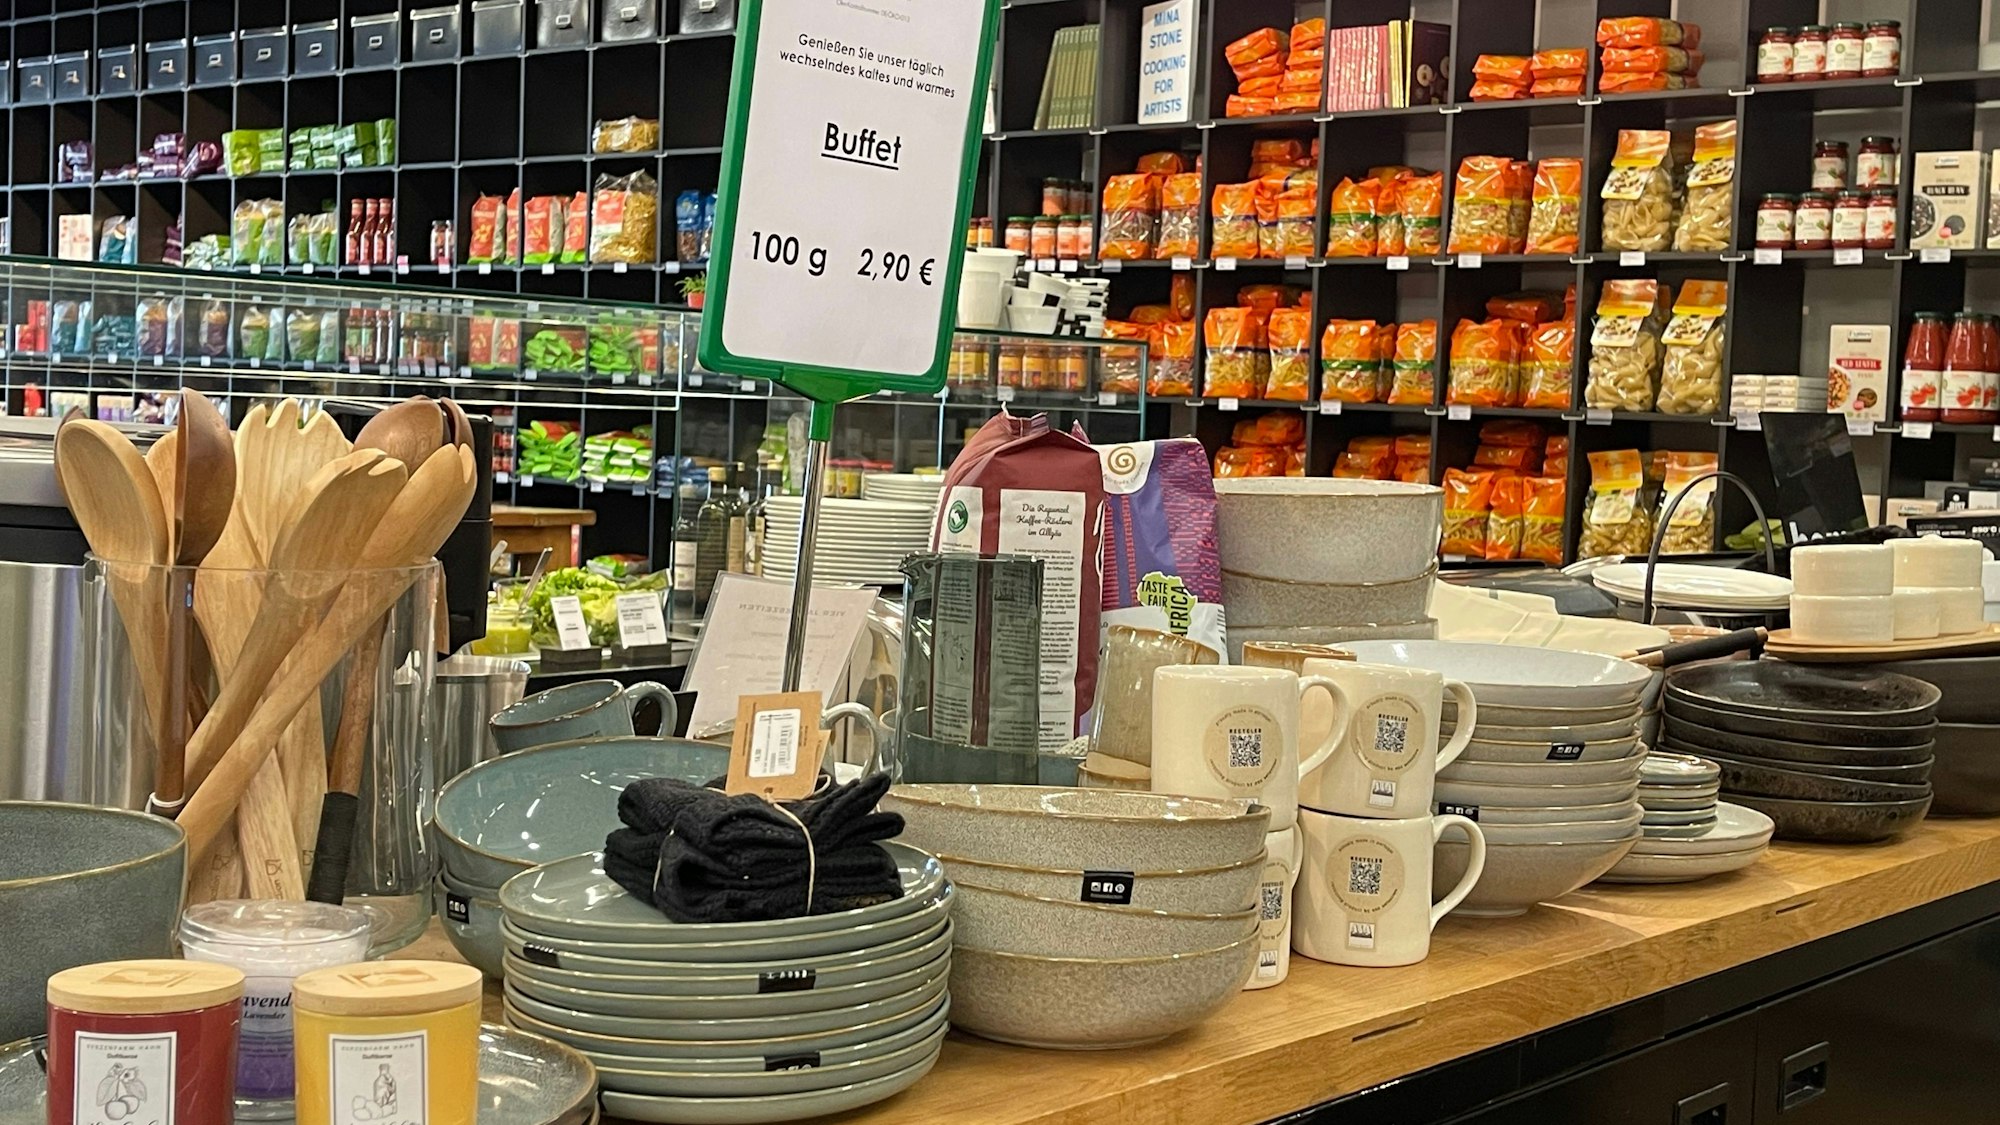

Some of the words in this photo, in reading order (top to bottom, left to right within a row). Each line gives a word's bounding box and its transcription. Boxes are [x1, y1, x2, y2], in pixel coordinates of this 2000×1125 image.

[1154, 8, 1180, 26] MINA
[1150, 30, 1182, 49] STONE
[798, 33, 856, 57] Genießen
[858, 47, 874, 61] Sie
[877, 54, 907, 68] unser
[908, 58, 944, 77] täglich
[779, 50, 855, 76] wechselndes
[858, 65, 890, 83] kaltes
[893, 77, 914, 89] und
[915, 80, 955, 98] warmes
[1143, 55, 1186, 75] COOKING
[1153, 78, 1173, 94] FOR
[1143, 98, 1182, 117] ARTISTS
[824, 122, 902, 164] Buffet
[752, 231, 800, 266] 100
[807, 247, 827, 277] g
[857, 248, 910, 282] 2,90
[919, 258, 935, 286] €
[1022, 504, 1035, 512] Die
[1037, 504, 1070, 517] Rapunzel
[1141, 580, 1169, 595] TASTE
[1148, 594, 1168, 608] FAIR
[243, 1010, 286, 1020] Lavender
